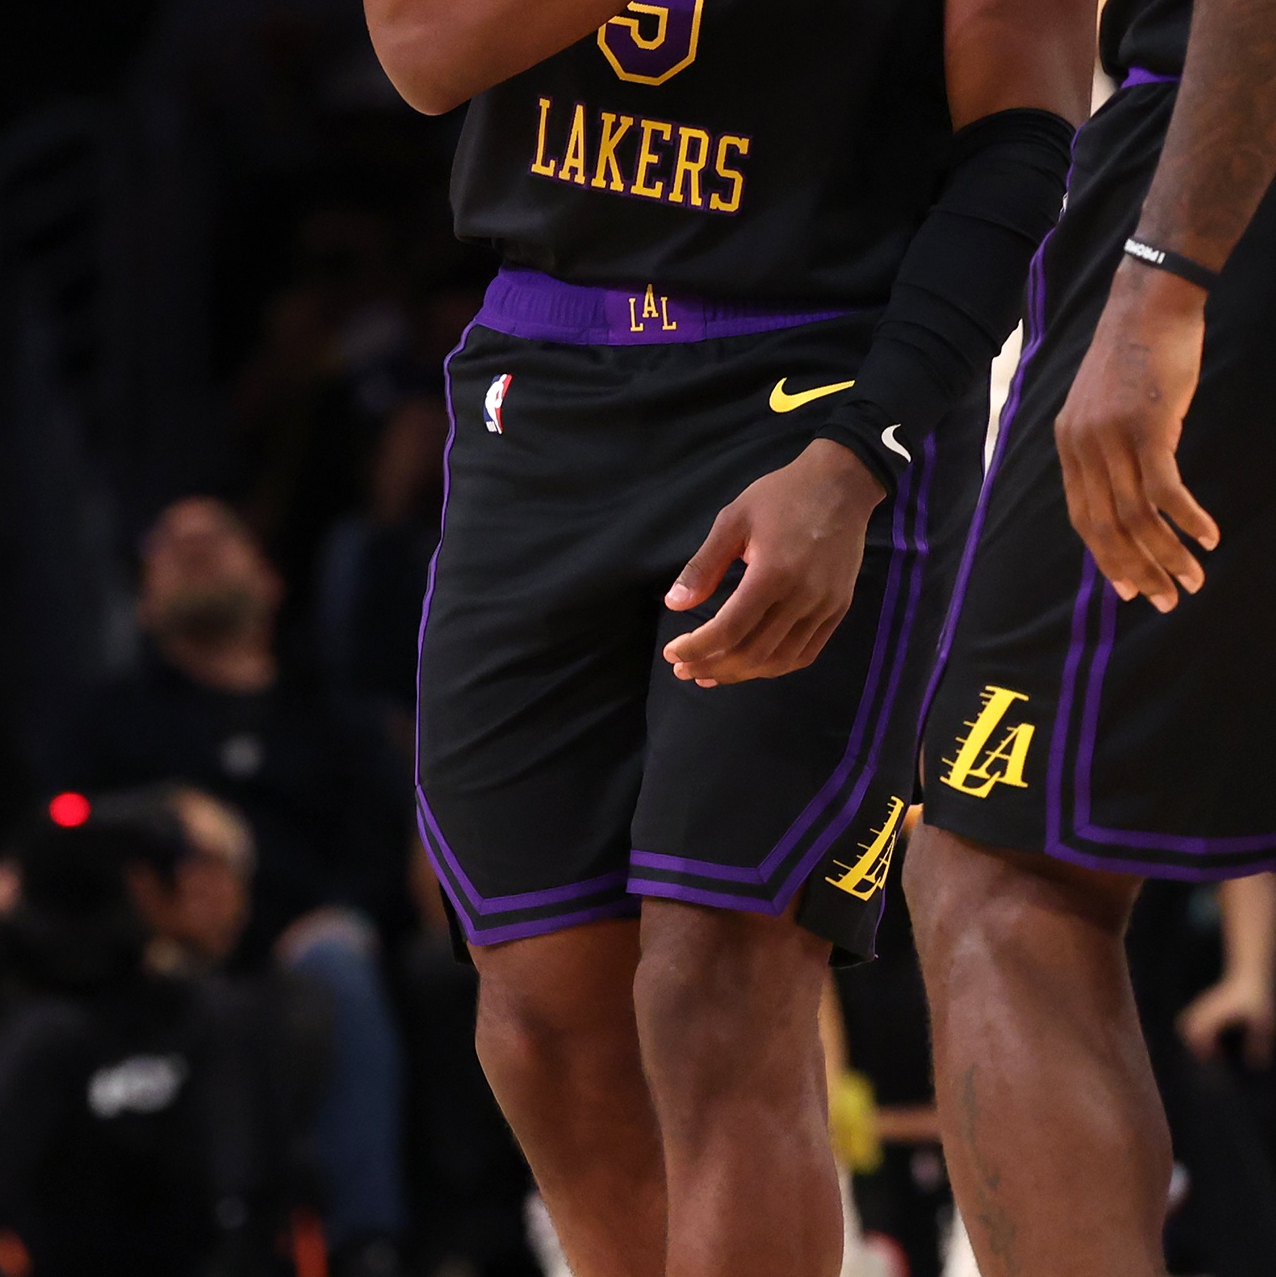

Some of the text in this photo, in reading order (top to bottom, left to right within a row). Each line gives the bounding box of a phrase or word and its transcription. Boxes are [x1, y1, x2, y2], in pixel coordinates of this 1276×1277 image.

[529, 96, 752, 214] LAKERS
[628, 283, 677, 332] LAL
[939, 685, 1036, 799] LA
